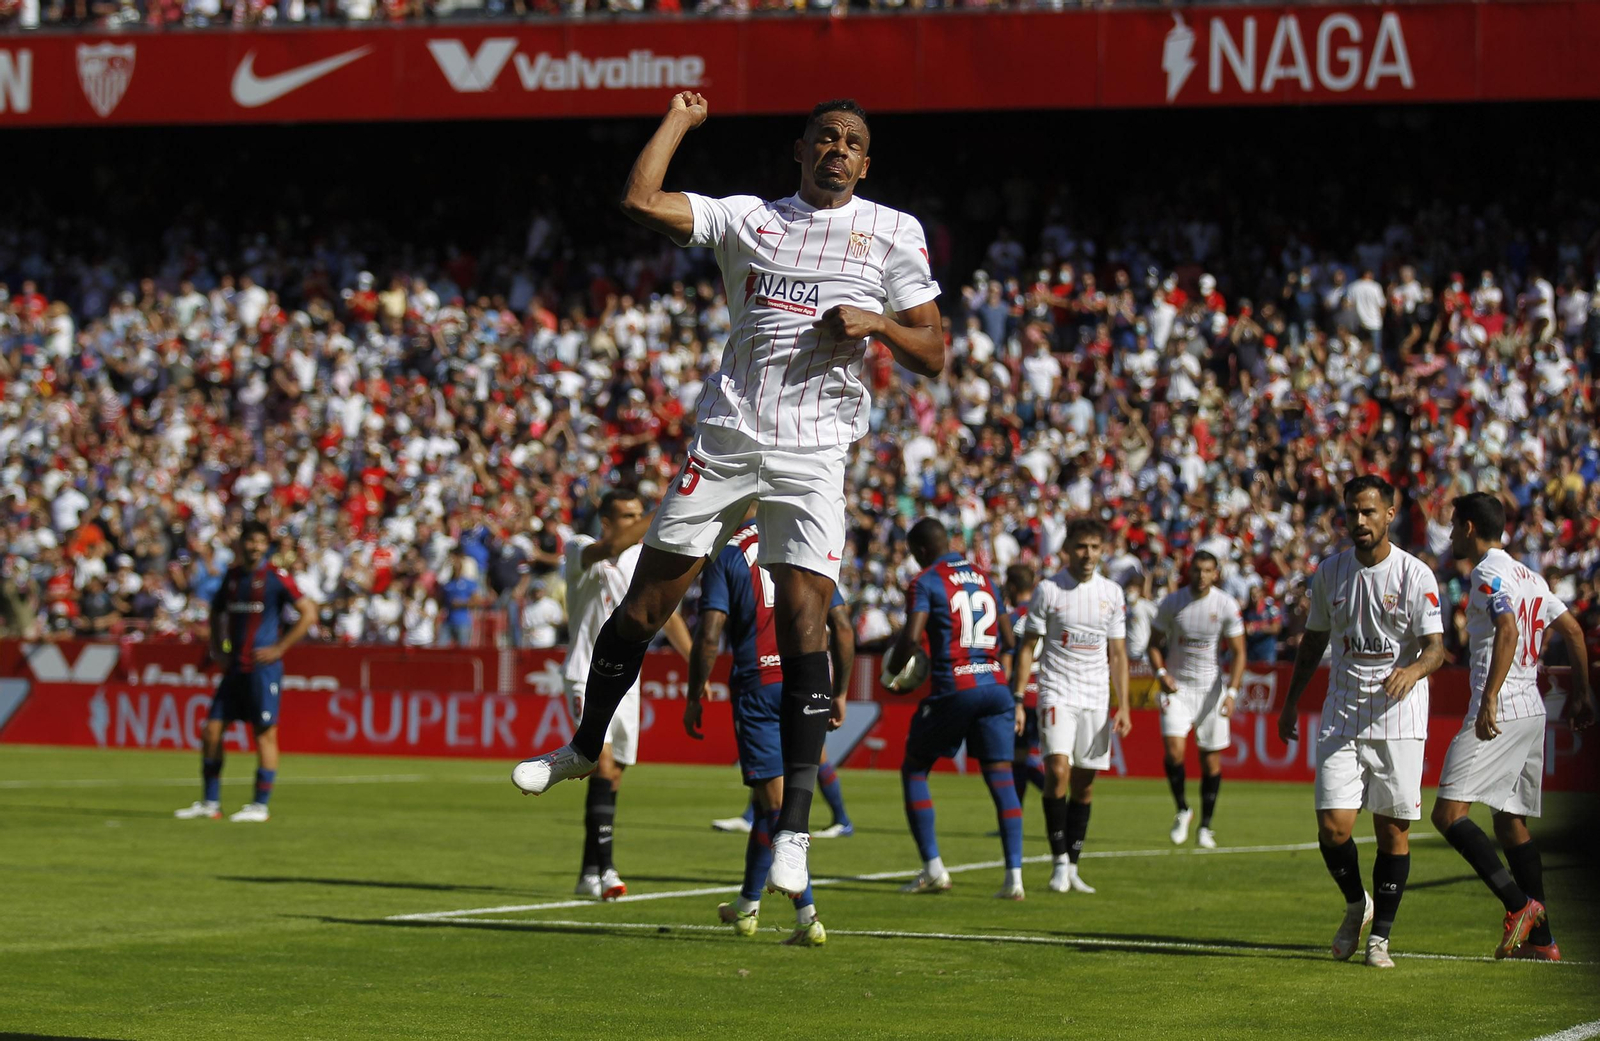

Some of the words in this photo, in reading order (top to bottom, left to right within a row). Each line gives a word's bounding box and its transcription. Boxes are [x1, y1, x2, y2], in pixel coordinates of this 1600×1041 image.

[513, 50, 706, 91] Valvoline
[1208, 12, 1415, 93] NAGA
[757, 272, 819, 307] NAGA
[767, 300, 789, 310] Investing
[788, 304, 803, 313] Super
[802, 308, 814, 316] App
[948, 570, 986, 588] MALSA
[950, 590, 997, 650] 12
[1518, 596, 1545, 667] 16
[1351, 637, 1394, 653] NAGA
[325, 688, 519, 748] SUPER
